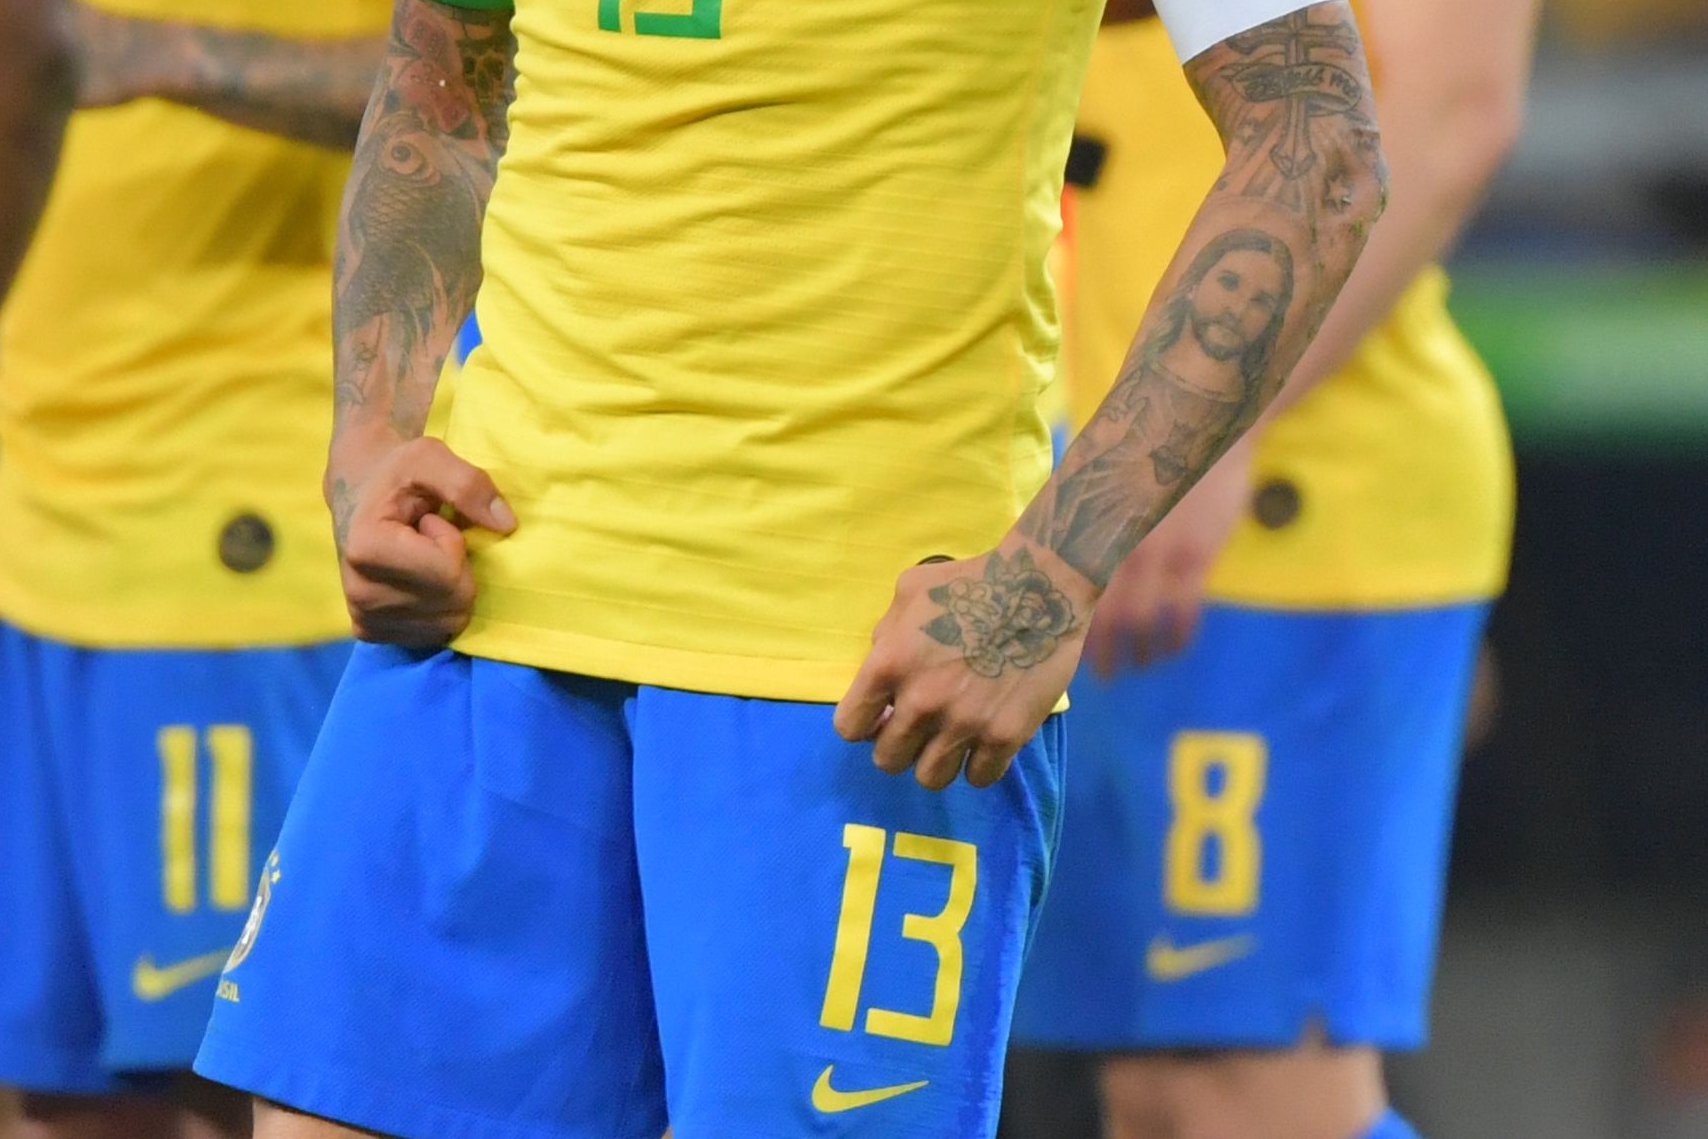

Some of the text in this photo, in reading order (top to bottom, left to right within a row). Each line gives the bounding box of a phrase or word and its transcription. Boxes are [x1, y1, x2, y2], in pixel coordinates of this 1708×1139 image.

[156, 723, 252, 912] 11
[1163, 728, 1268, 915] 8
[820, 823, 977, 1046] 13
